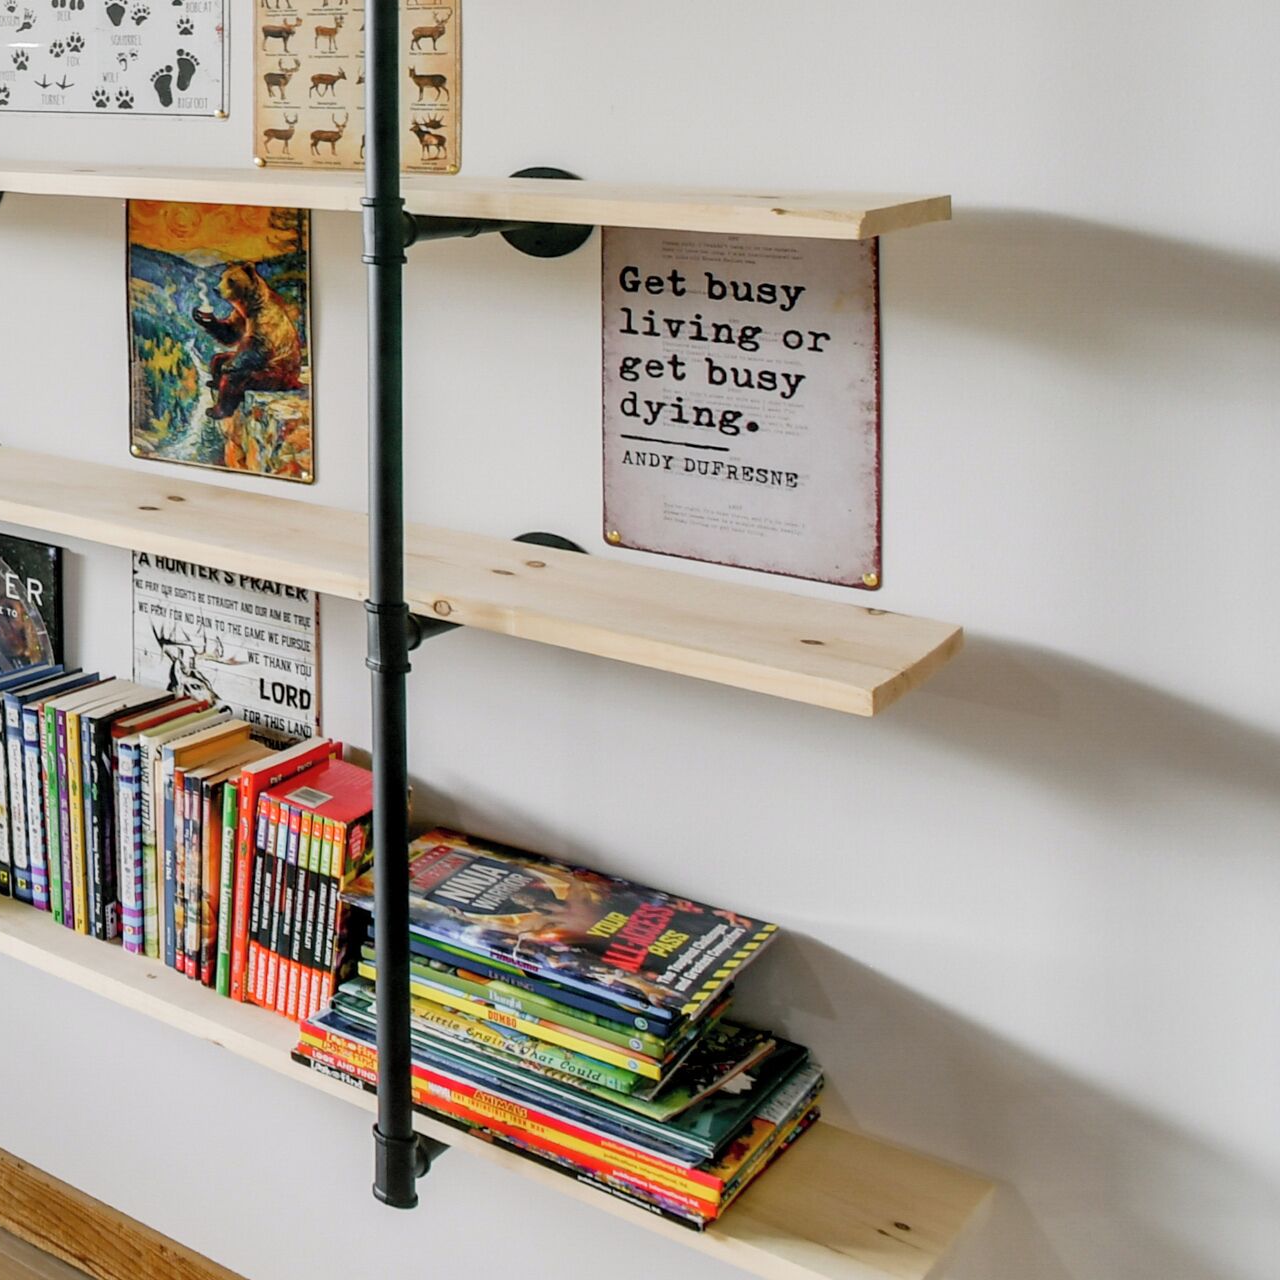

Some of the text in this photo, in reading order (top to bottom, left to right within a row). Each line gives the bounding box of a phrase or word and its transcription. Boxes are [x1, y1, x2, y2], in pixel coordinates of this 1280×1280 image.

[185, 1, 213, 14] BOBCAT
[66, 55, 81, 68] FOX
[41, 93, 66, 106] TURKEY
[176, 96, 209, 110] BIGFOOT
[619, 265, 806, 312] Get busy
[619, 307, 763, 352] living
[782, 329, 831, 353] or
[619, 354, 806, 400] get busy
[620, 391, 760, 437] dying.
[622, 450, 799, 489] ANDY DUFRESNE
[138, 551, 310, 603] A HUNTER'S PRAYER
[7, 607, 18, 618] TO
[134, 578, 312, 629] WE PRAY OUR SIGHTS BE STRAIGHT AND OUR AIM BE TRUE
[138, 600, 312, 653] WE PRAY FOR NO PAIN TO THE GAME WE PURSUE
[247, 650, 312, 678] WE THANK YOU
[259, 677, 312, 711] LORD
[243, 708, 313, 739] FOR THIS LAND
[140, 744, 151, 831] STUART LITTLE
[218, 826, 234, 955] Christmas Unwrapped
[434, 863, 534, 911] NINJA WARRIOR
[586, 911, 629, 939] YOUR
[600, 902, 676, 974] ALL-ACCESS
[647, 928, 690, 958] PASS
[656, 923, 729, 985] The Toughest Challenges
[683, 954, 717, 981] Greatest
[674, 976, 693, 992] and
[487, 1009, 518, 1029] DUMBO
[419, 1008, 602, 1082] Little Engine That Could
[311, 1049, 377, 1082] LOOK AND FIND
[473, 1088, 528, 1120] ANIMALS
[600, 1139, 637, 1158] publications
[576, 1174, 613, 1194] publications
[611, 1169, 649, 1188] publications
